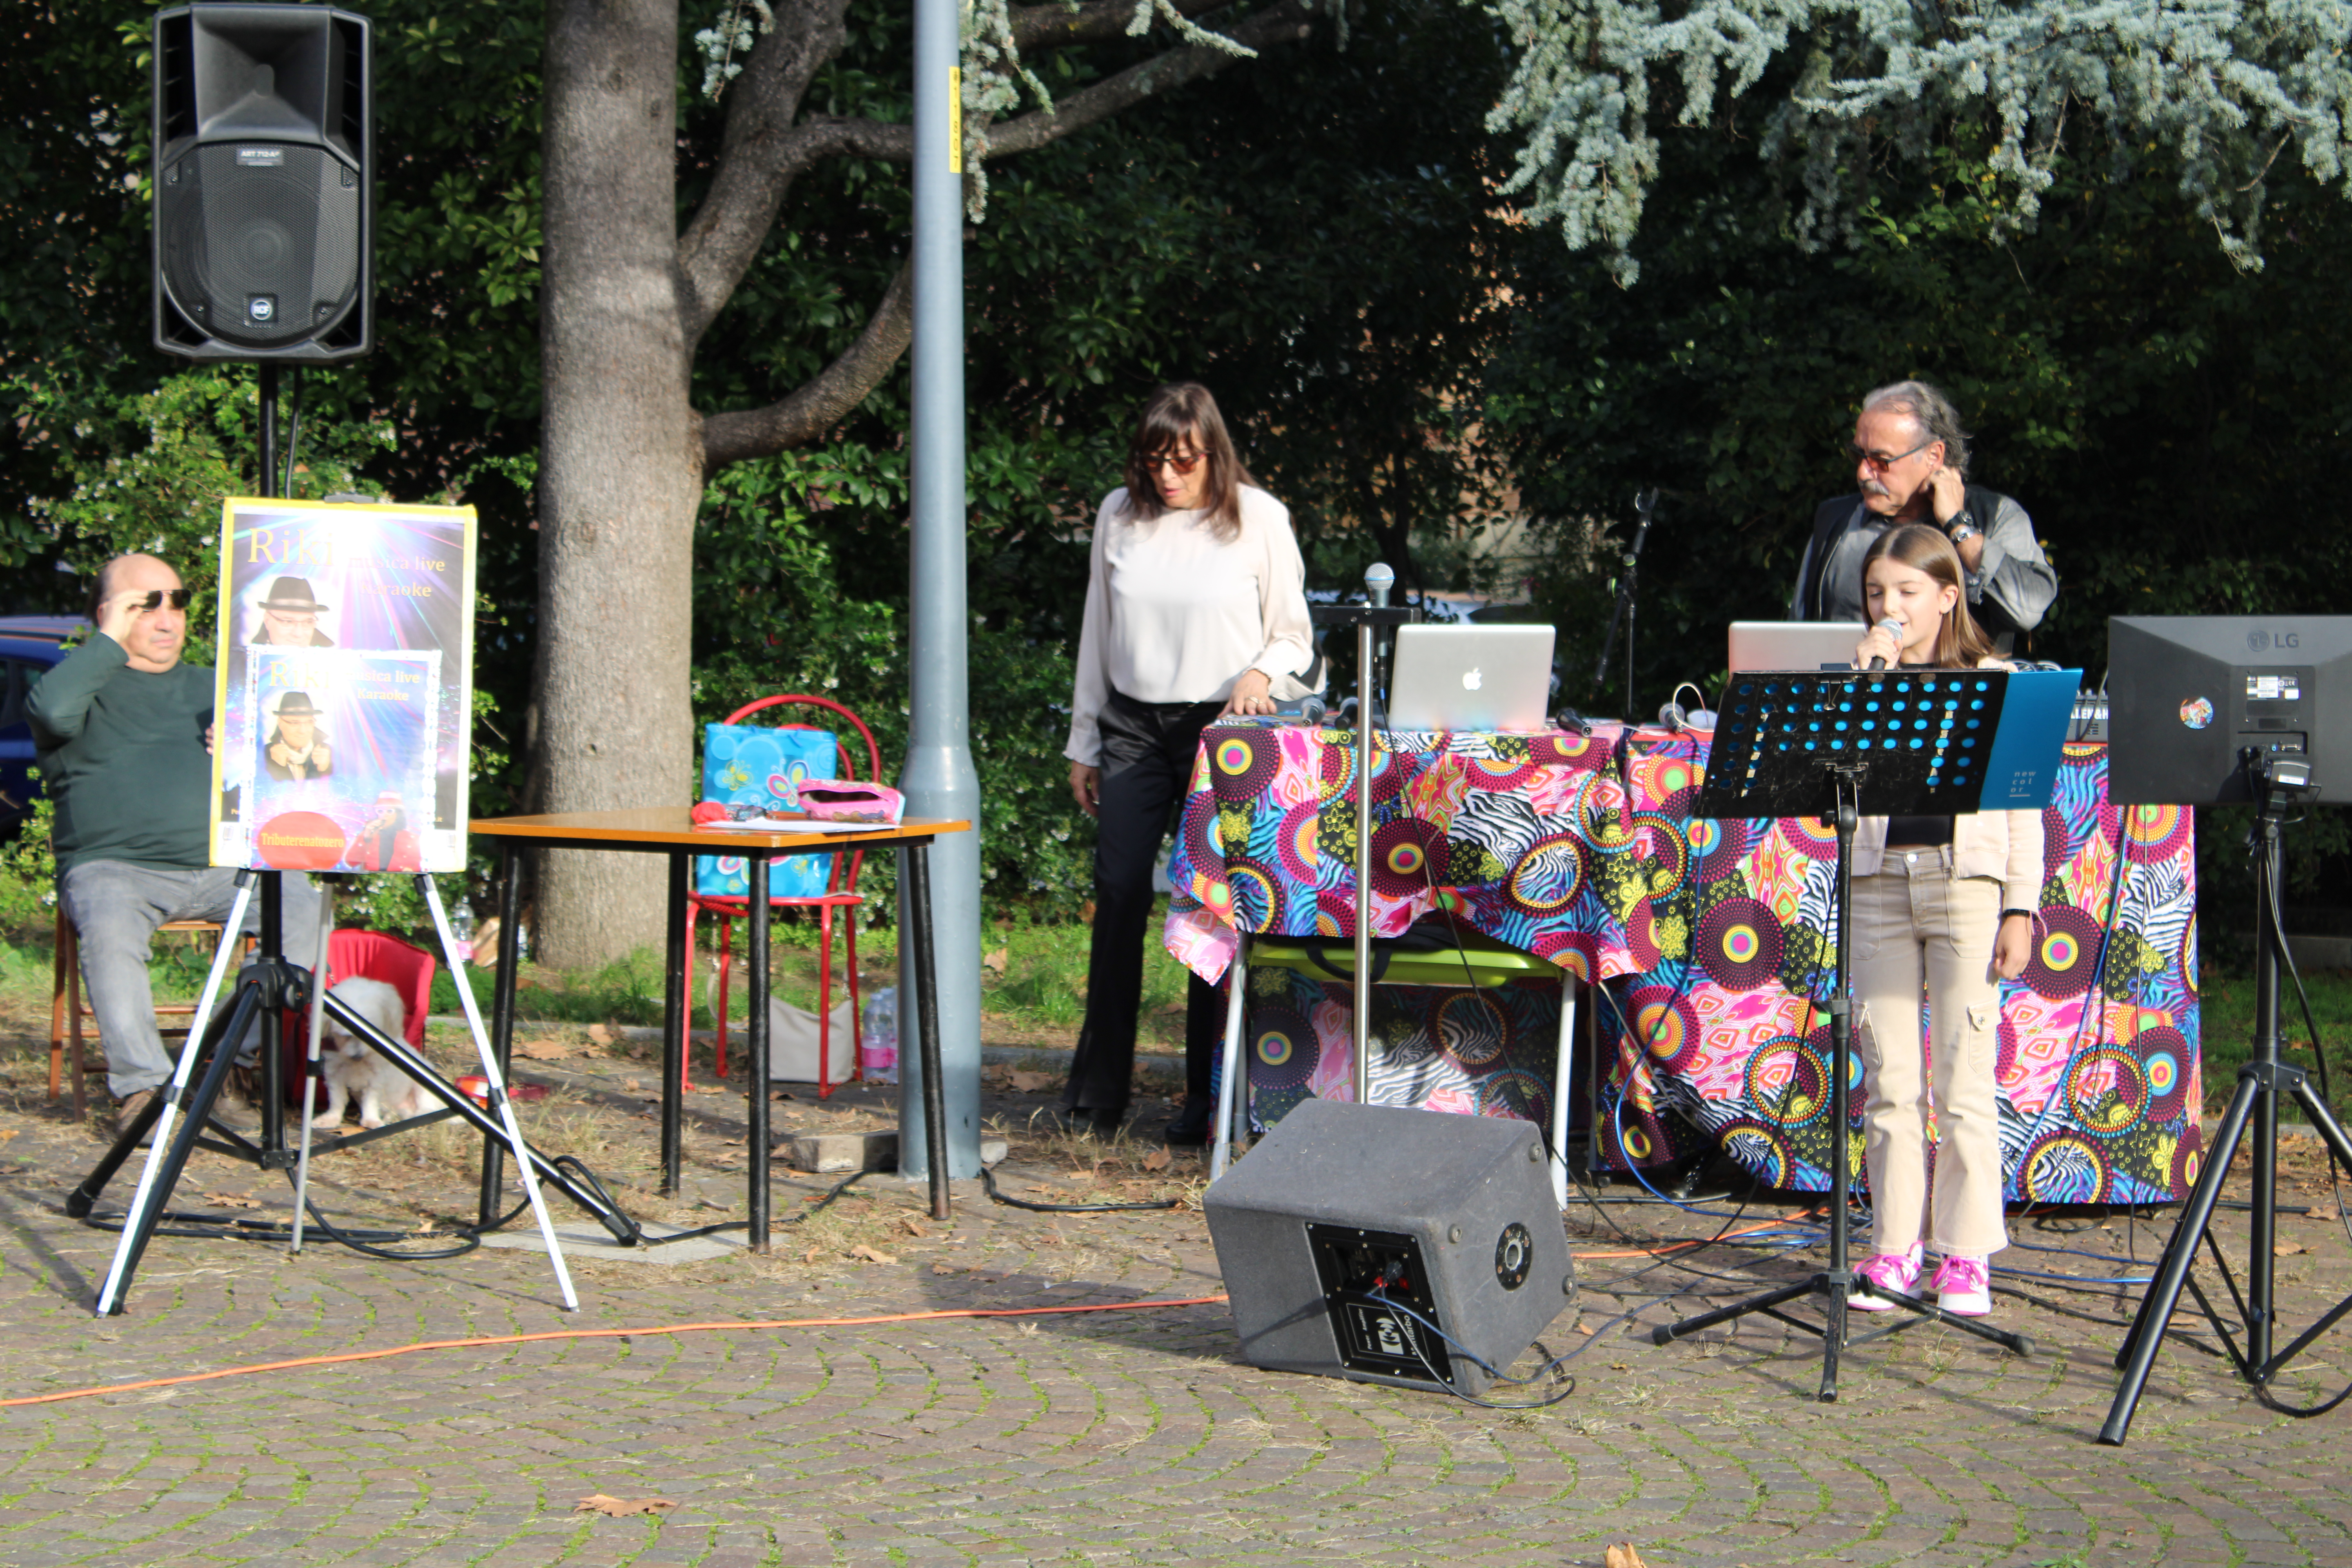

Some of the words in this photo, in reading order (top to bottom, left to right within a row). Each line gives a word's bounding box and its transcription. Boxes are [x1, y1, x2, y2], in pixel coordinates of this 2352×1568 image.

[253, 306, 270, 314] RCF
[248, 528, 334, 566] Riki
[348, 555, 409, 570] musica
[415, 555, 445, 572] live
[361, 581, 432, 597] Karaoke
[2274, 633, 2299, 648] LG
[269, 661, 329, 688] Riki
[395, 670, 420, 684] live
[357, 688, 409, 701] Karaoke
[261, 832, 344, 848] Tributerenatozero
[1359, 1308, 1368, 1331] Amplifier
